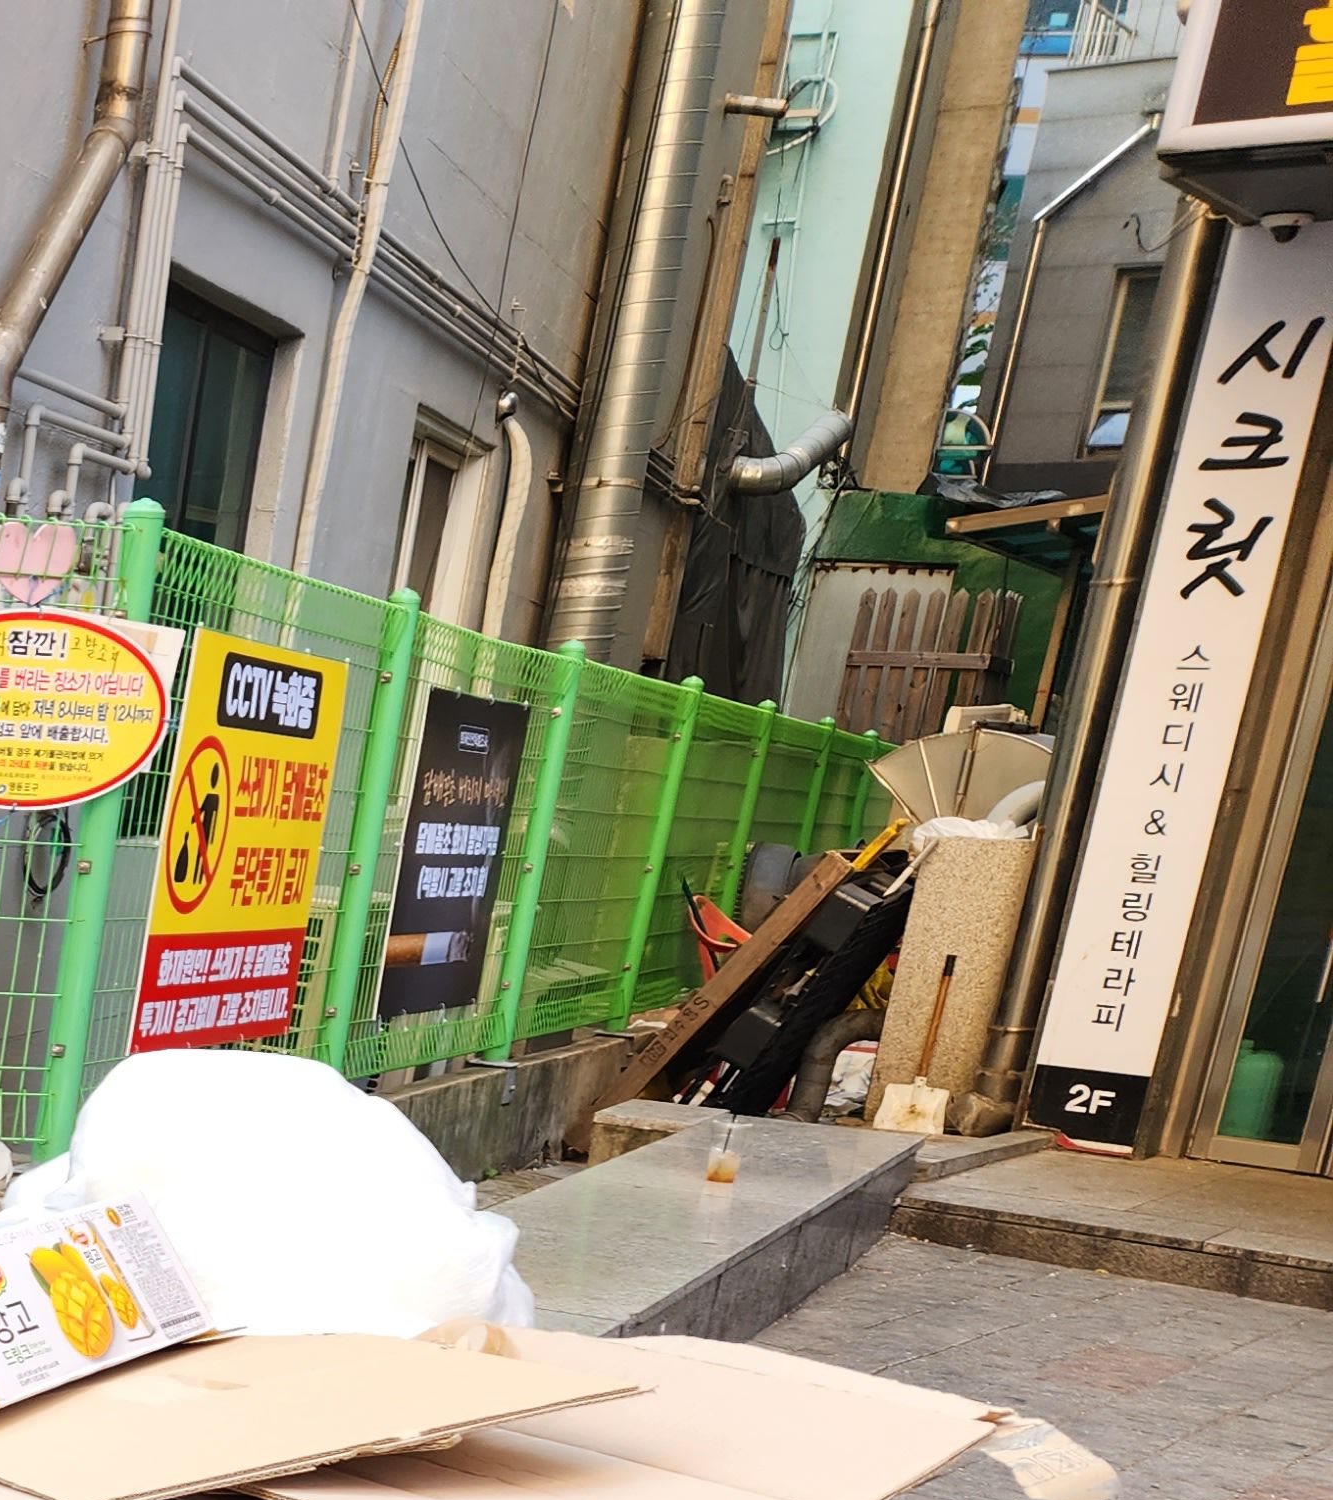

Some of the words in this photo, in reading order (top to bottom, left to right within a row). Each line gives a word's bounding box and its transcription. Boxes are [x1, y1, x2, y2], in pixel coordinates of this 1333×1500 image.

[1179, 315, 1326, 600] 시크릿
[9, 631, 67, 659] 잠깐!
[14, 669, 52, 693] 버리는
[54, 672, 92, 695] 장소가
[95, 674, 145, 698] 아닙니다
[225, 662, 274, 721] CCTV
[272, 669, 317, 730] 녹화중
[12, 700, 32, 718] 담아
[33, 699, 56, 720] 저녁
[58, 700, 95, 721] 8시부터
[98, 702, 110, 722] 밤
[19, 722, 43, 740] 앞에
[47, 724, 109, 744] 배출합시다.
[1148, 644, 1212, 794] 스웨디시
[234, 755, 280, 827] 쓰레기,
[279, 761, 329, 822] 담배꽁초
[1143, 808, 1168, 837] &
[230, 847, 286, 907] 무단투기
[282, 848, 310, 905] 금지
[156, 948, 213, 987] 화재원인!
[208, 946, 246, 982] 쓰레기
[241, 945, 257, 979] 및
[252, 941, 293, 978] 담배꽁초
[1091, 852, 1163, 1033] 힐링테라피
[139, 1000, 177, 1038] 투기시
[173, 994, 221, 1033] 경고없이
[216, 992, 243, 1027] 고발
[237, 987, 290, 1024] 조치됩니다.
[1064, 1082, 1117, 1116] 2F
[2, 1344, 34, 1366] 드링크
